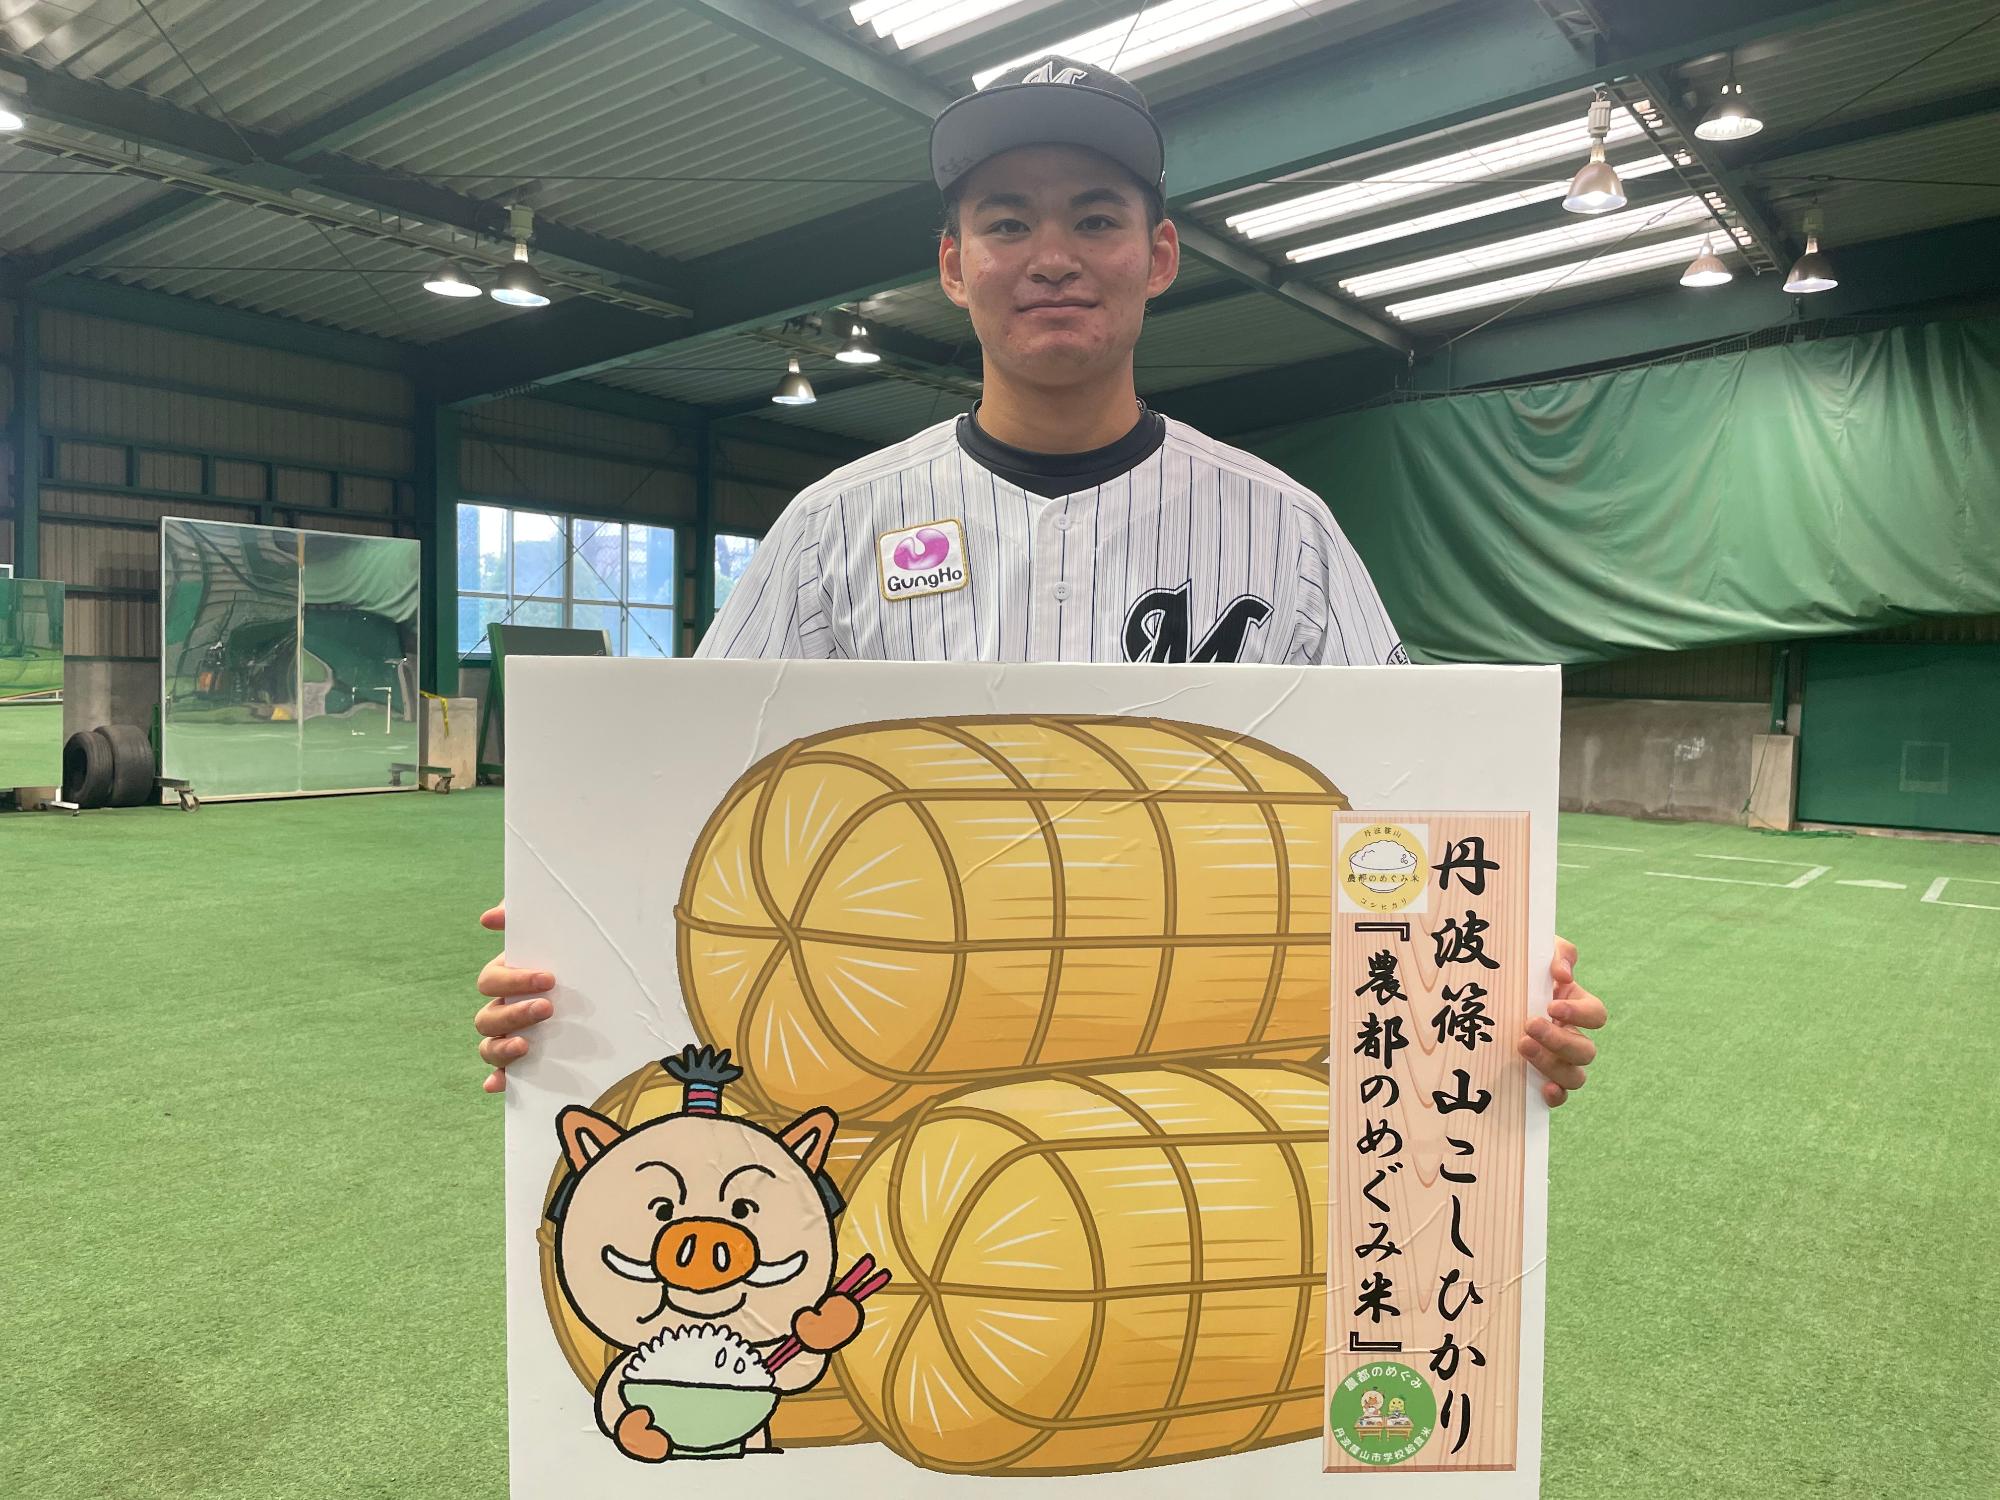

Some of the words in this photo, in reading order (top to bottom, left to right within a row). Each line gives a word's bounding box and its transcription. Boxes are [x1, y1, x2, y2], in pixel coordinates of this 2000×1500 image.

[887, 566, 963, 592] GungHo
[1429, 836, 1501, 1455] 丹波篠山こしひかり
